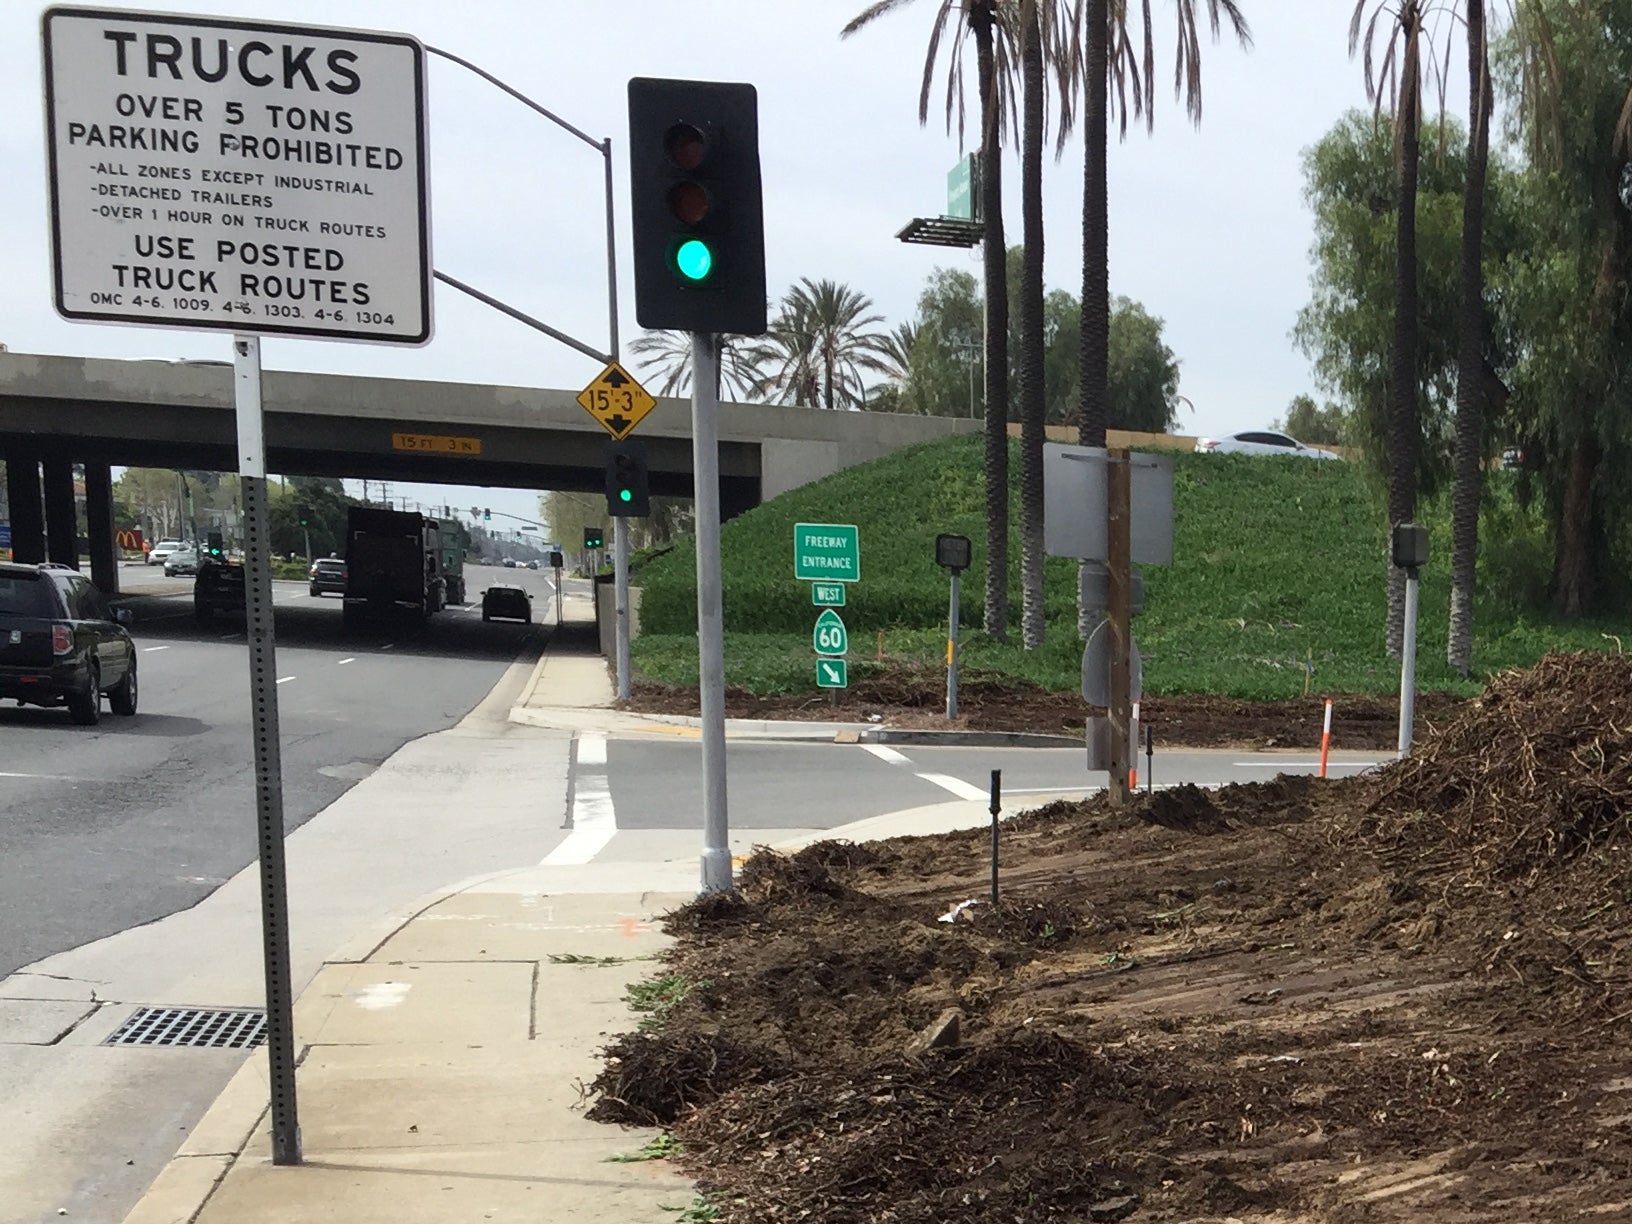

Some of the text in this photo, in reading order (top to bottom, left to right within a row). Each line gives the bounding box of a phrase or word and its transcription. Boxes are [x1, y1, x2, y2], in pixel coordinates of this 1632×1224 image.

[104, 30, 361, 95] TRUCKS
[116, 93, 353, 134] OVER 5 TONS
[68, 122, 403, 170] PARKING PROHIBITED
[90, 162, 374, 195] -ALL ZONES EXCEPT INDUSTRIAL
[90, 184, 273, 208] -DETACHED TRAILERS
[92, 205, 386, 238] -OVER 1 HOUR ON TRUCK ROUTES
[134, 234, 344, 271] USE POSTED
[112, 264, 370, 305] TRUCK ROUTES
[90, 292, 122, 305] OMC
[355, 311, 394, 326] 1304
[805, 535, 848, 548] FREEWAY
[802, 555, 852, 569] ENTRANCE
[817, 587, 840, 601] WEST
[819, 627, 842, 648] 60
